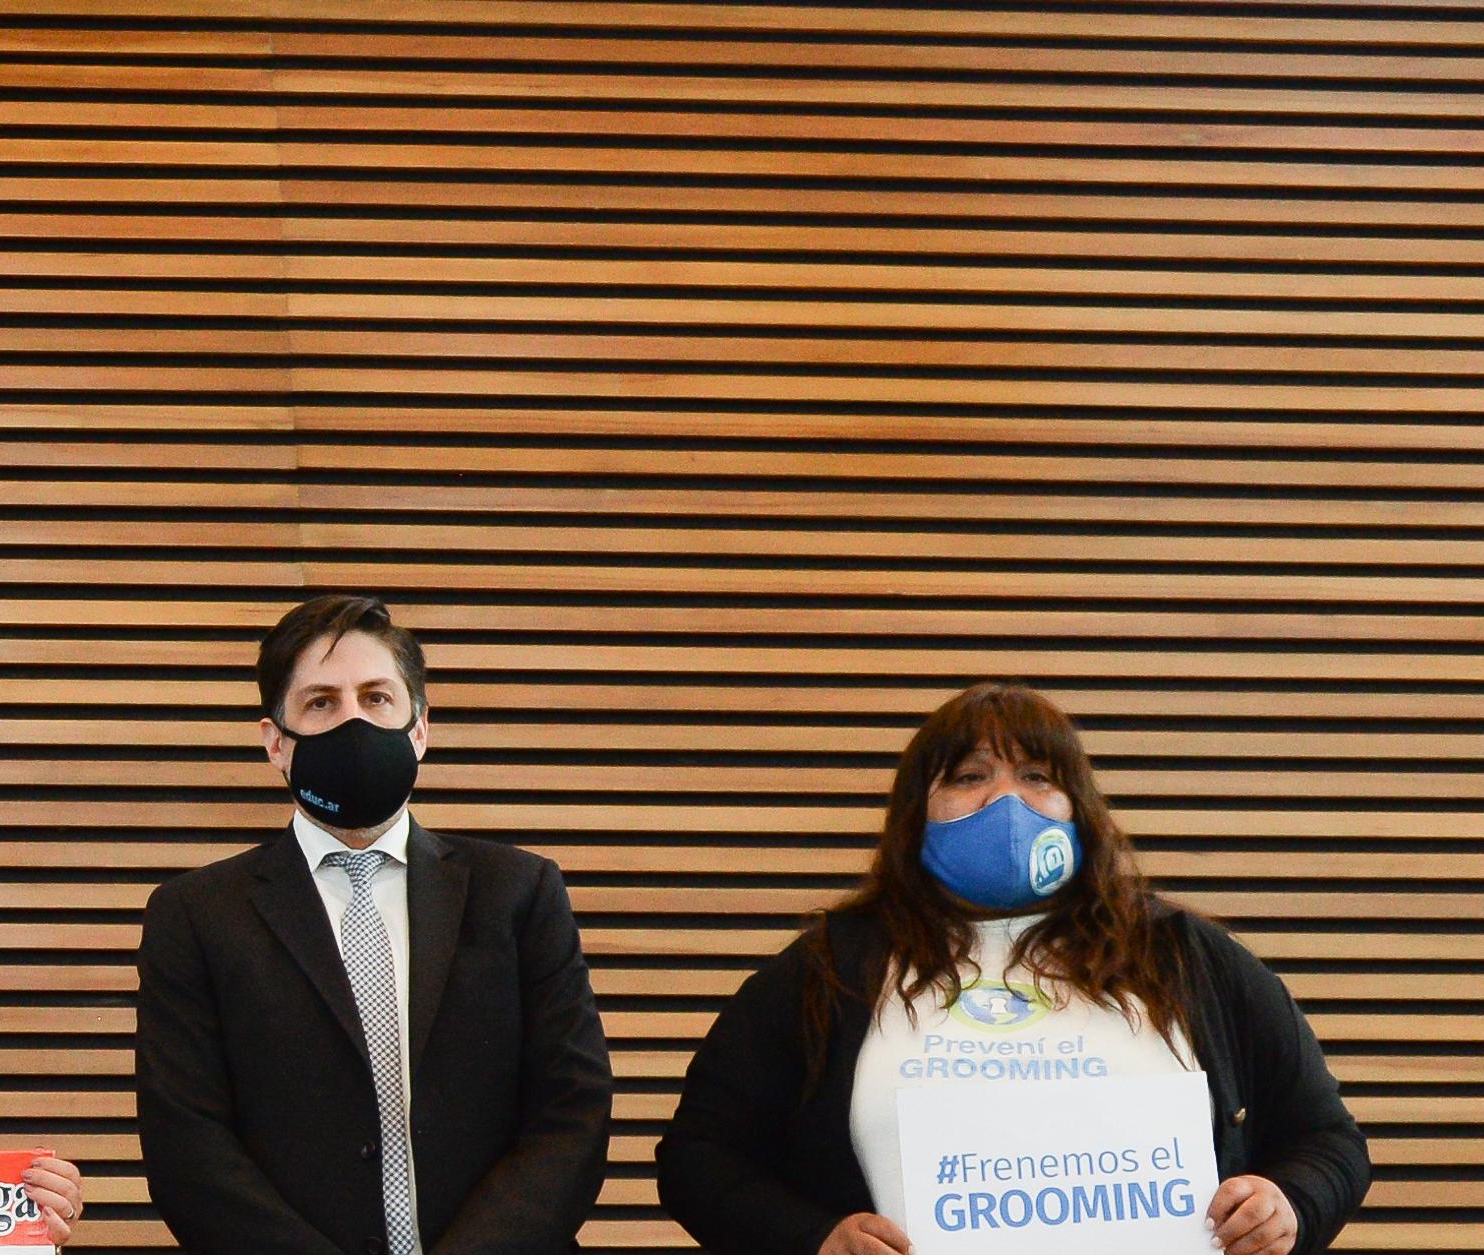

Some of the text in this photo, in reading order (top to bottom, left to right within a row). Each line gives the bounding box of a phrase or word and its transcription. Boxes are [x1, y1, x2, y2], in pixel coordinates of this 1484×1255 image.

[923, 1034, 1084, 1056] Prevení el
[899, 1056, 1109, 1081] GROOMING
[937, 1136, 1185, 1185] #Frenemos el
[934, 1178, 1196, 1232] GROOMING
